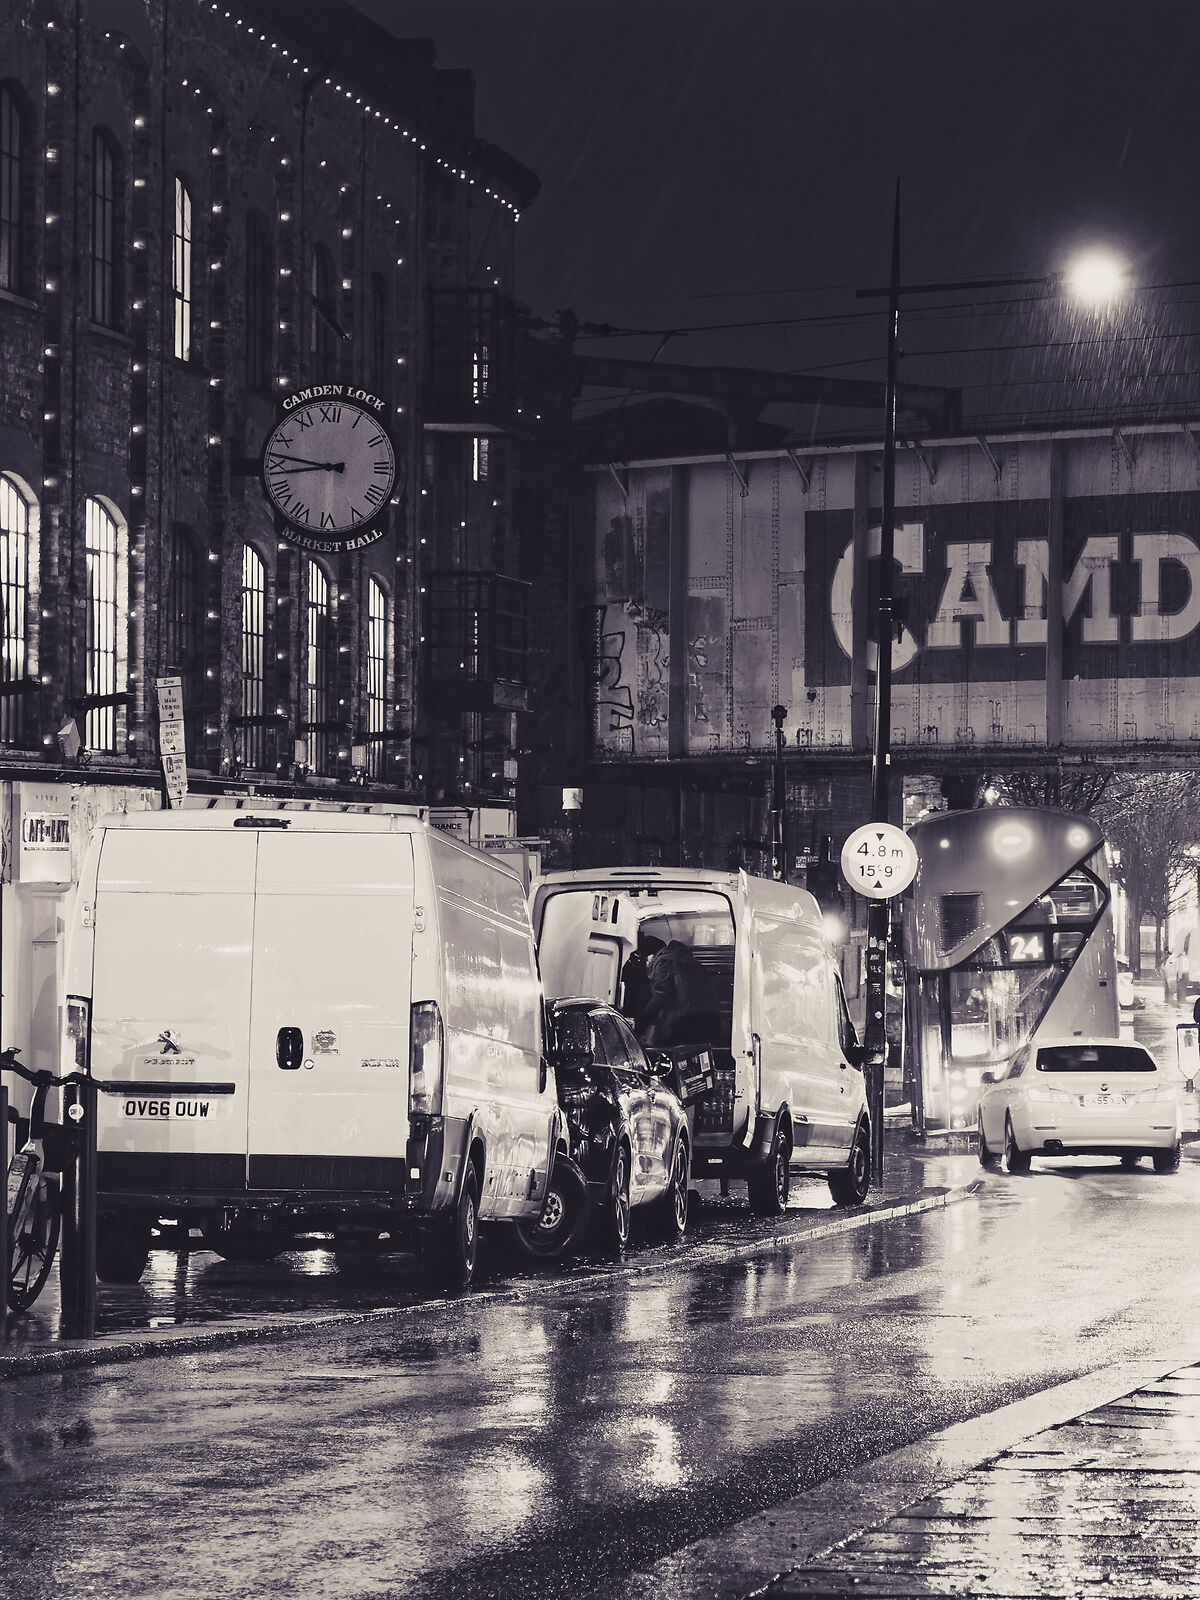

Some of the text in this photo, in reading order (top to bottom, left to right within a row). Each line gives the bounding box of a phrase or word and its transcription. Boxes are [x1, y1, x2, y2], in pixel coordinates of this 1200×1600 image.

[282, 385, 386, 411] CAMDEN LOCK
[281, 527, 383, 552] MARKET HALL
[857, 842, 903, 858] 4.8 m
[1010, 936, 1043, 960] 24
[125, 1100, 209, 1118] OV66 OUW
